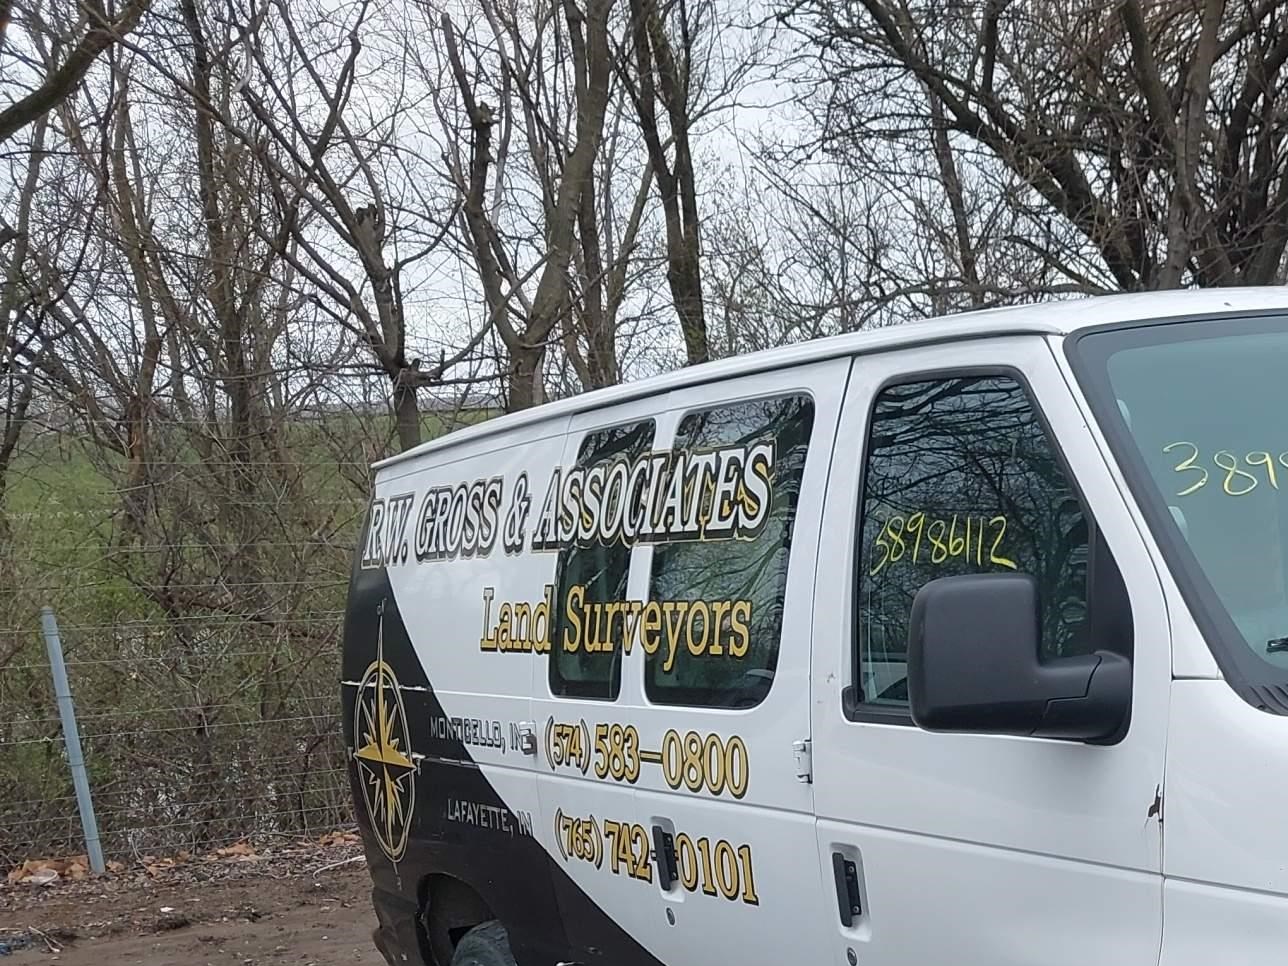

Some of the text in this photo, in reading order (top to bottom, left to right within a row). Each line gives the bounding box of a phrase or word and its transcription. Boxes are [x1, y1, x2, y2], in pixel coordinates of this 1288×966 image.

[414, 475, 504, 565] GROSS
[503, 470, 532, 556] &
[531, 438, 776, 553] ASSOCIATES
[480, 583, 752, 675] Land Surveyors
[430, 716, 506, 755] MONTICELLO,
[544, 715, 749, 799] (574) 583-0800
[447, 798, 534, 838] LAFAYETTE, IN
[554, 807, 603, 870] (765)
